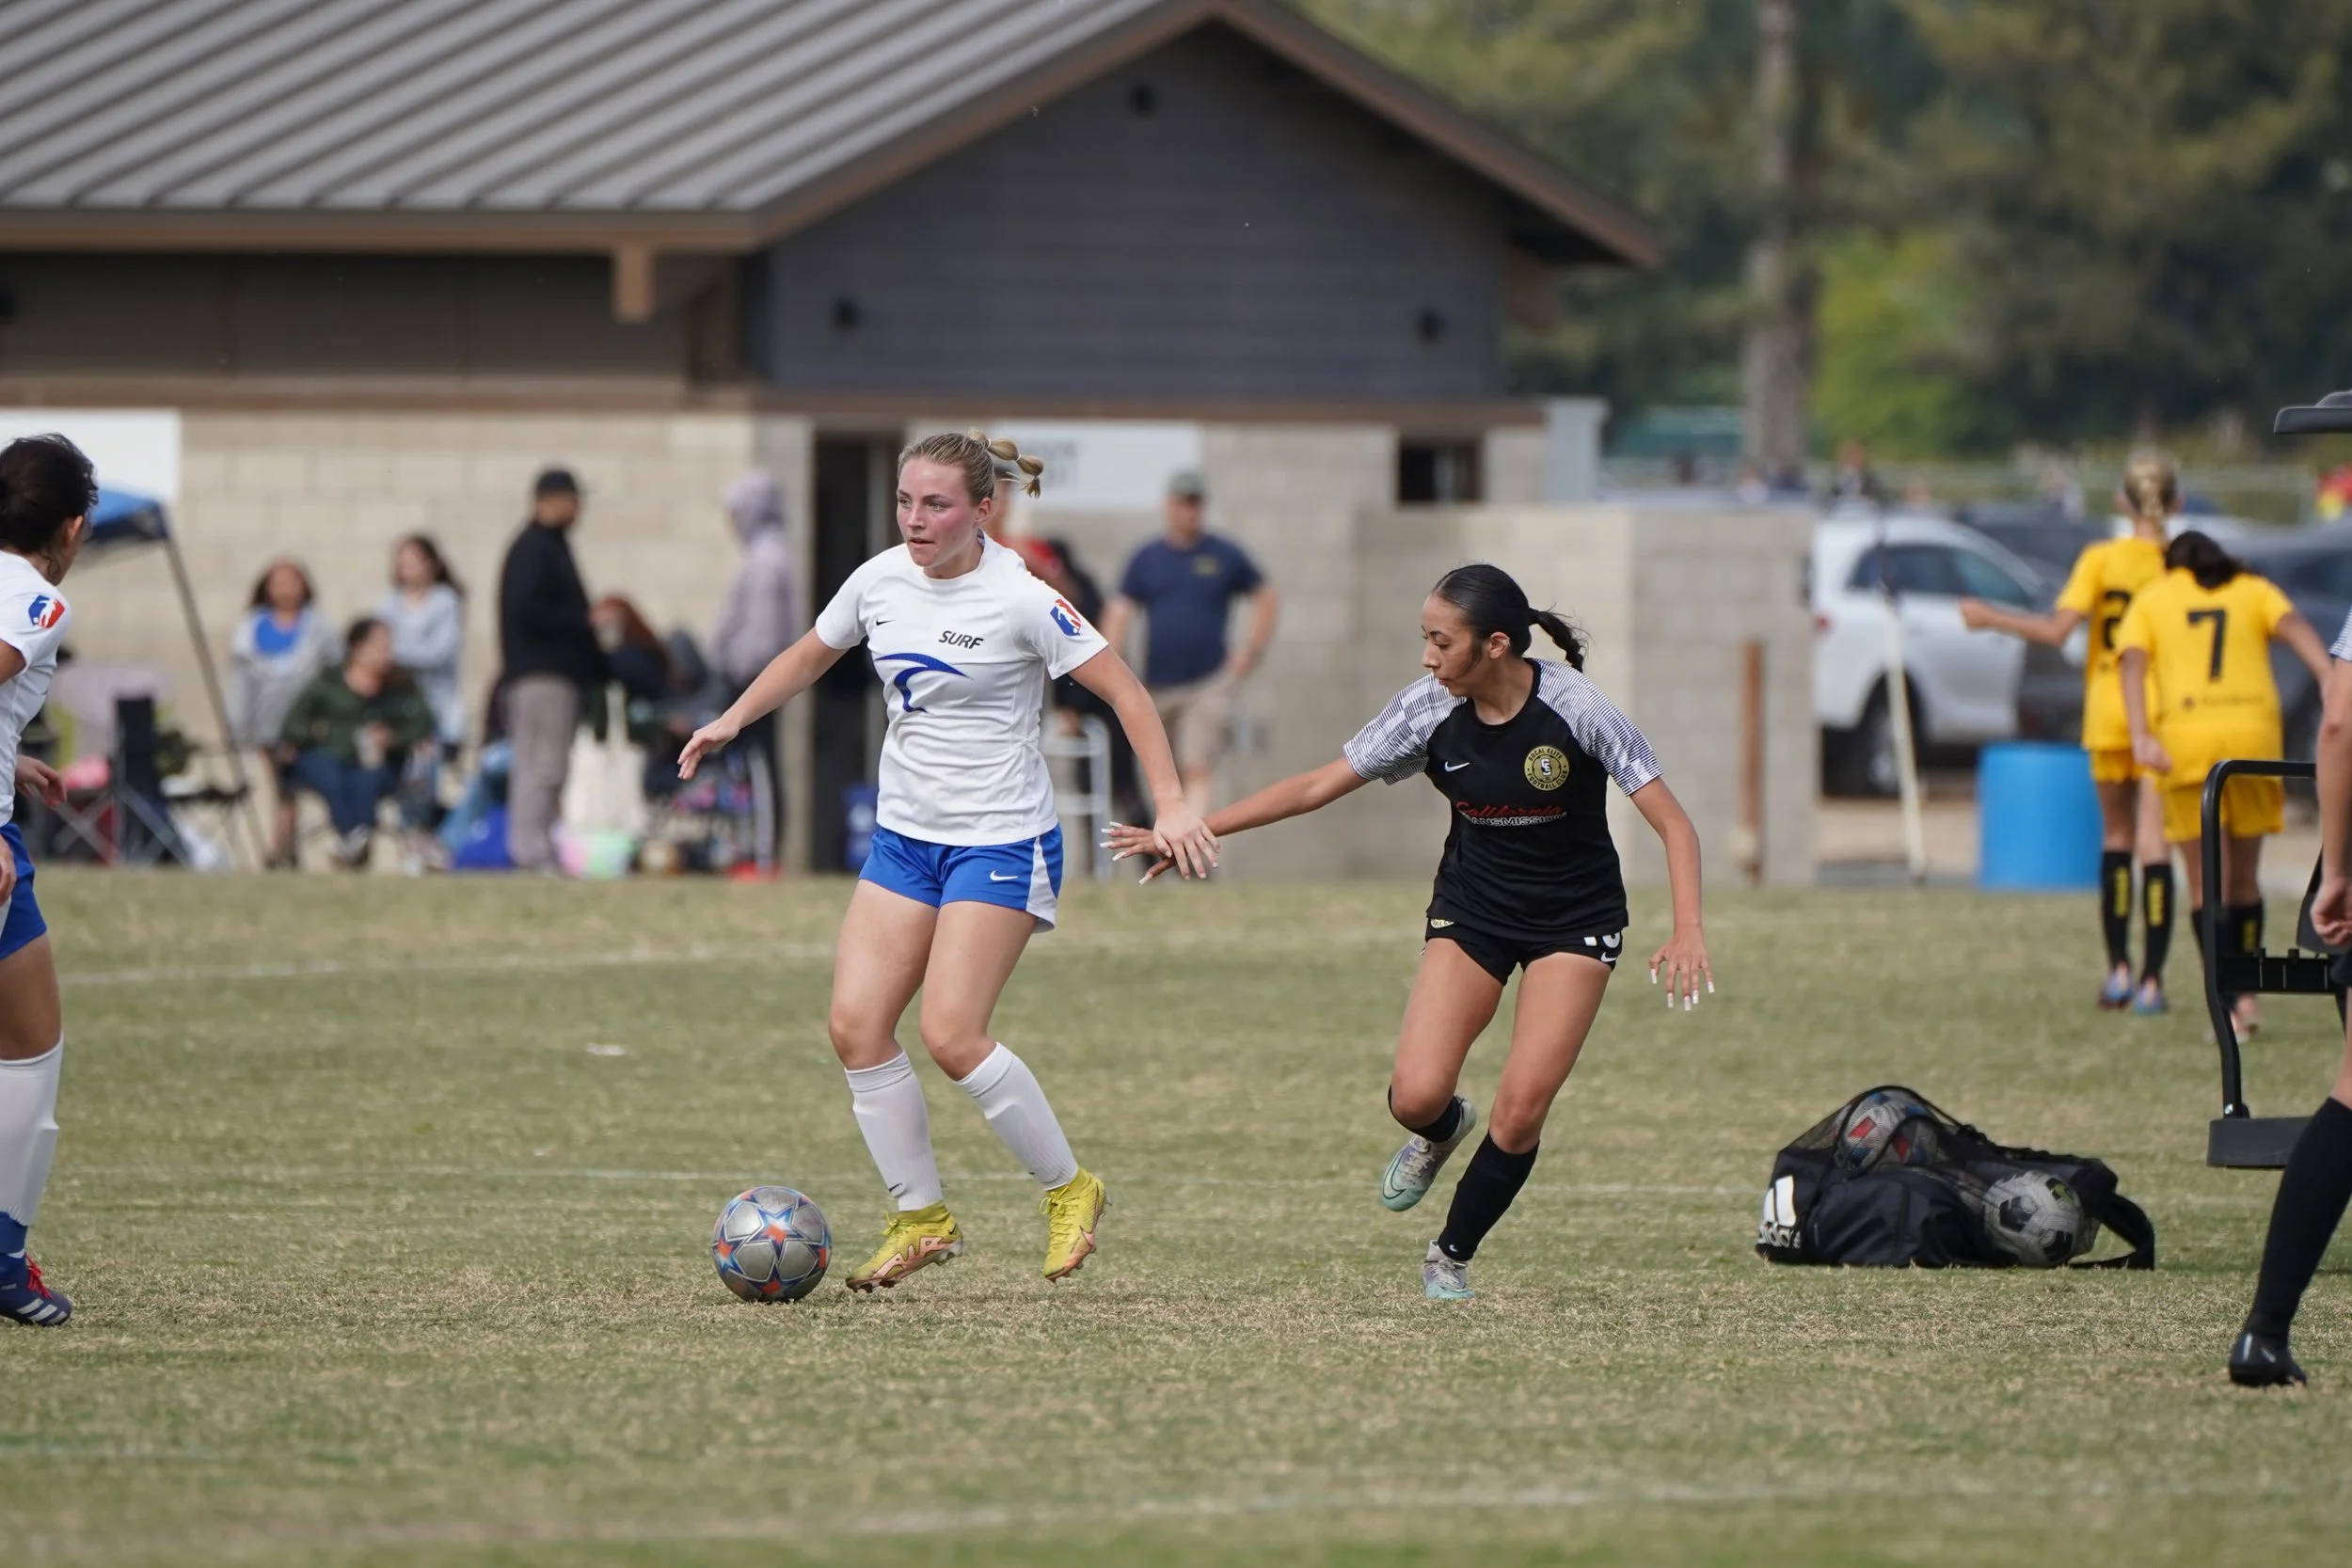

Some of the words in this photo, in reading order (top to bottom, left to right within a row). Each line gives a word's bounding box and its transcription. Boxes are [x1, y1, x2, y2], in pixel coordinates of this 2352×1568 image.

[938, 630, 984, 650] SURF
[2186, 608, 2227, 681] 7
[1528, 748, 1546, 762] SOCAL
[1547, 748, 1564, 760] ELITE
[1527, 772, 1557, 790] FOOTBALL
[1555, 769, 1568, 786] CLUB
